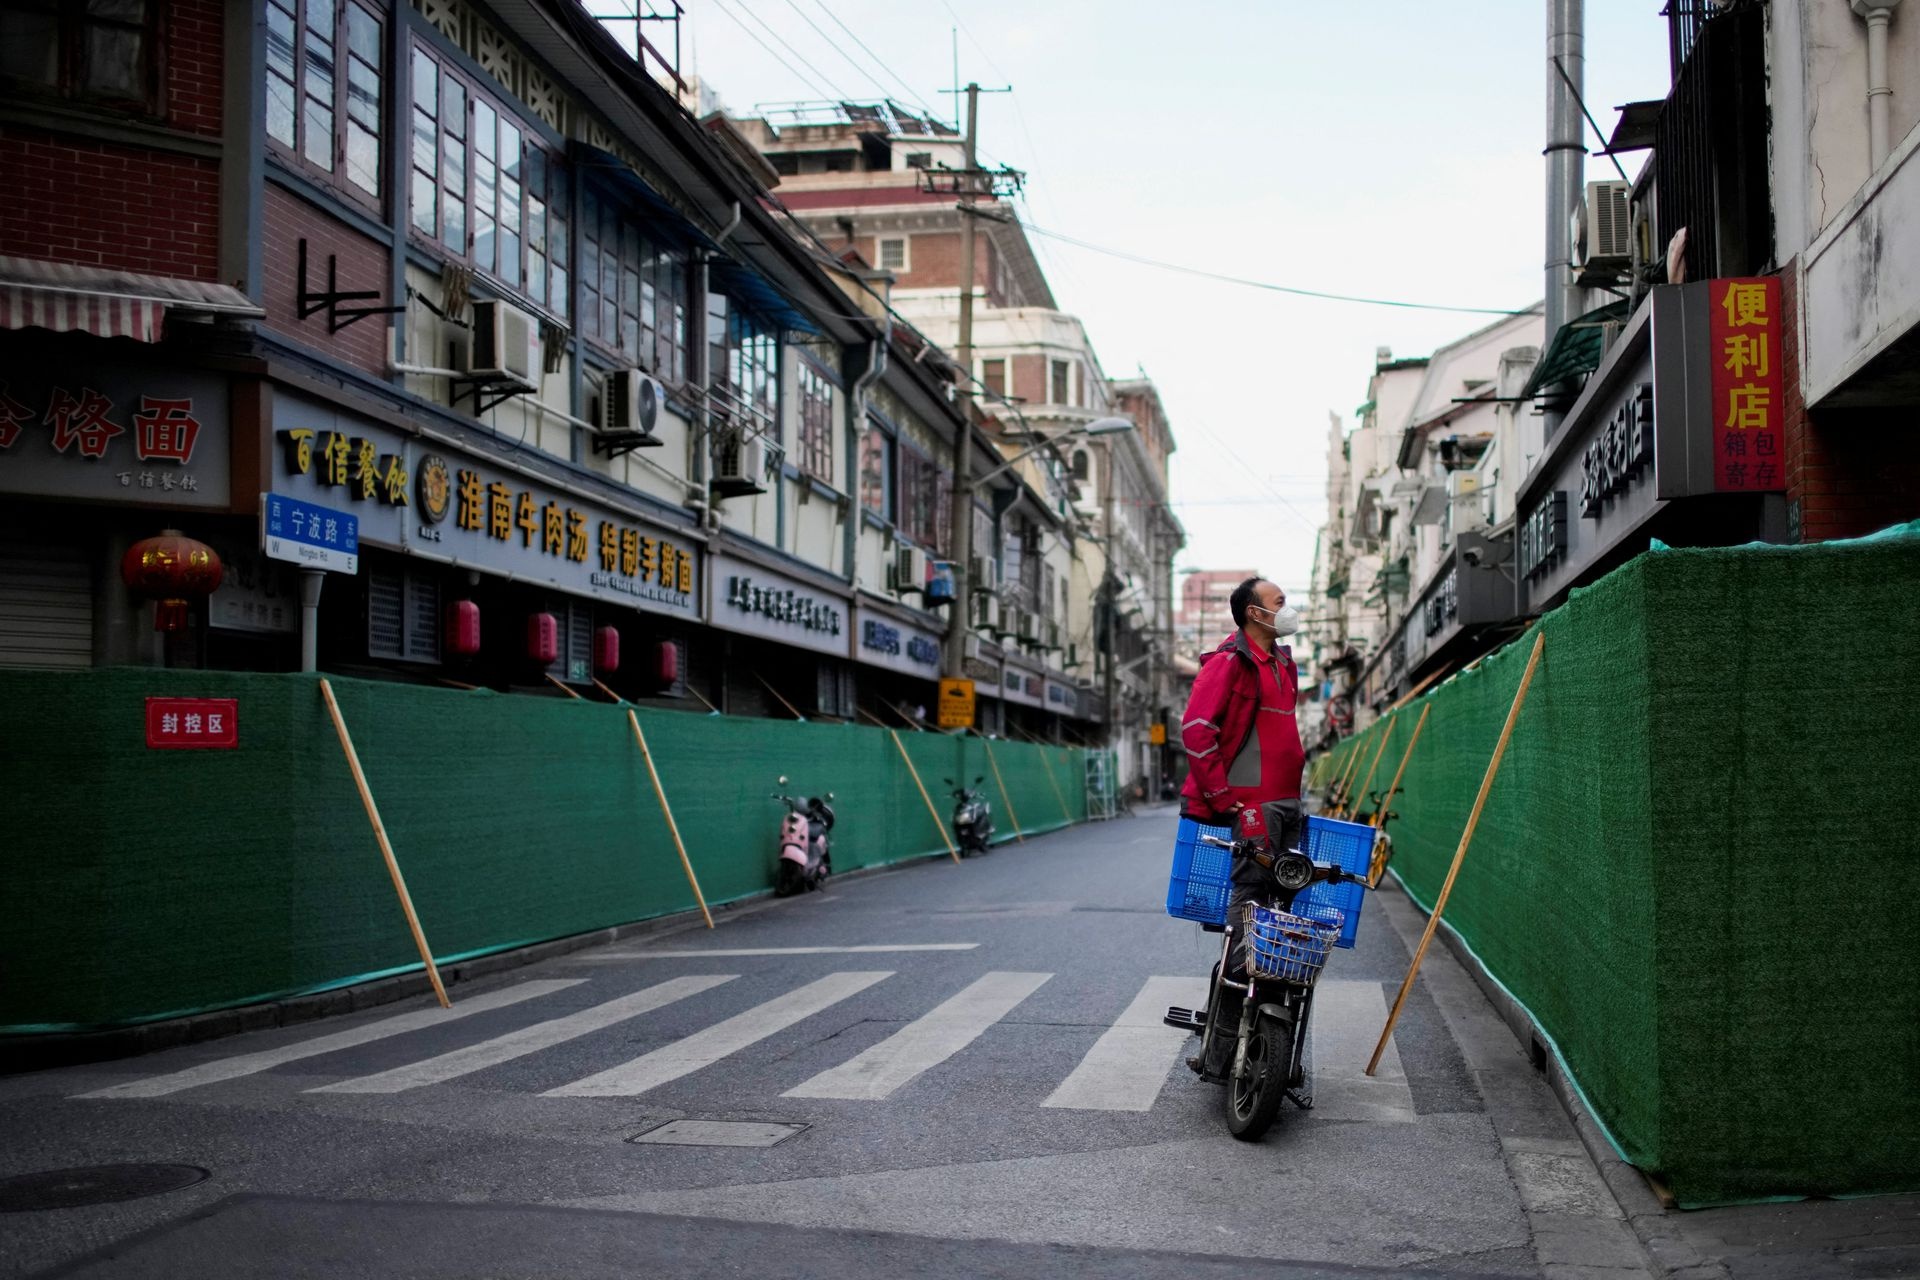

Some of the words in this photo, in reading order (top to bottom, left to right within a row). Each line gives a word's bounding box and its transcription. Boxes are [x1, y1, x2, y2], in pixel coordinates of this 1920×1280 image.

[1722, 282, 1770, 429] 便利店
[116, 471, 198, 491] 百信餐饮
[286, 428, 409, 505] 百信餐饮
[292, 508, 338, 544] 宁波路
[459, 469, 588, 563] 淮南牛肉汤
[162, 713, 223, 734] 封控区
